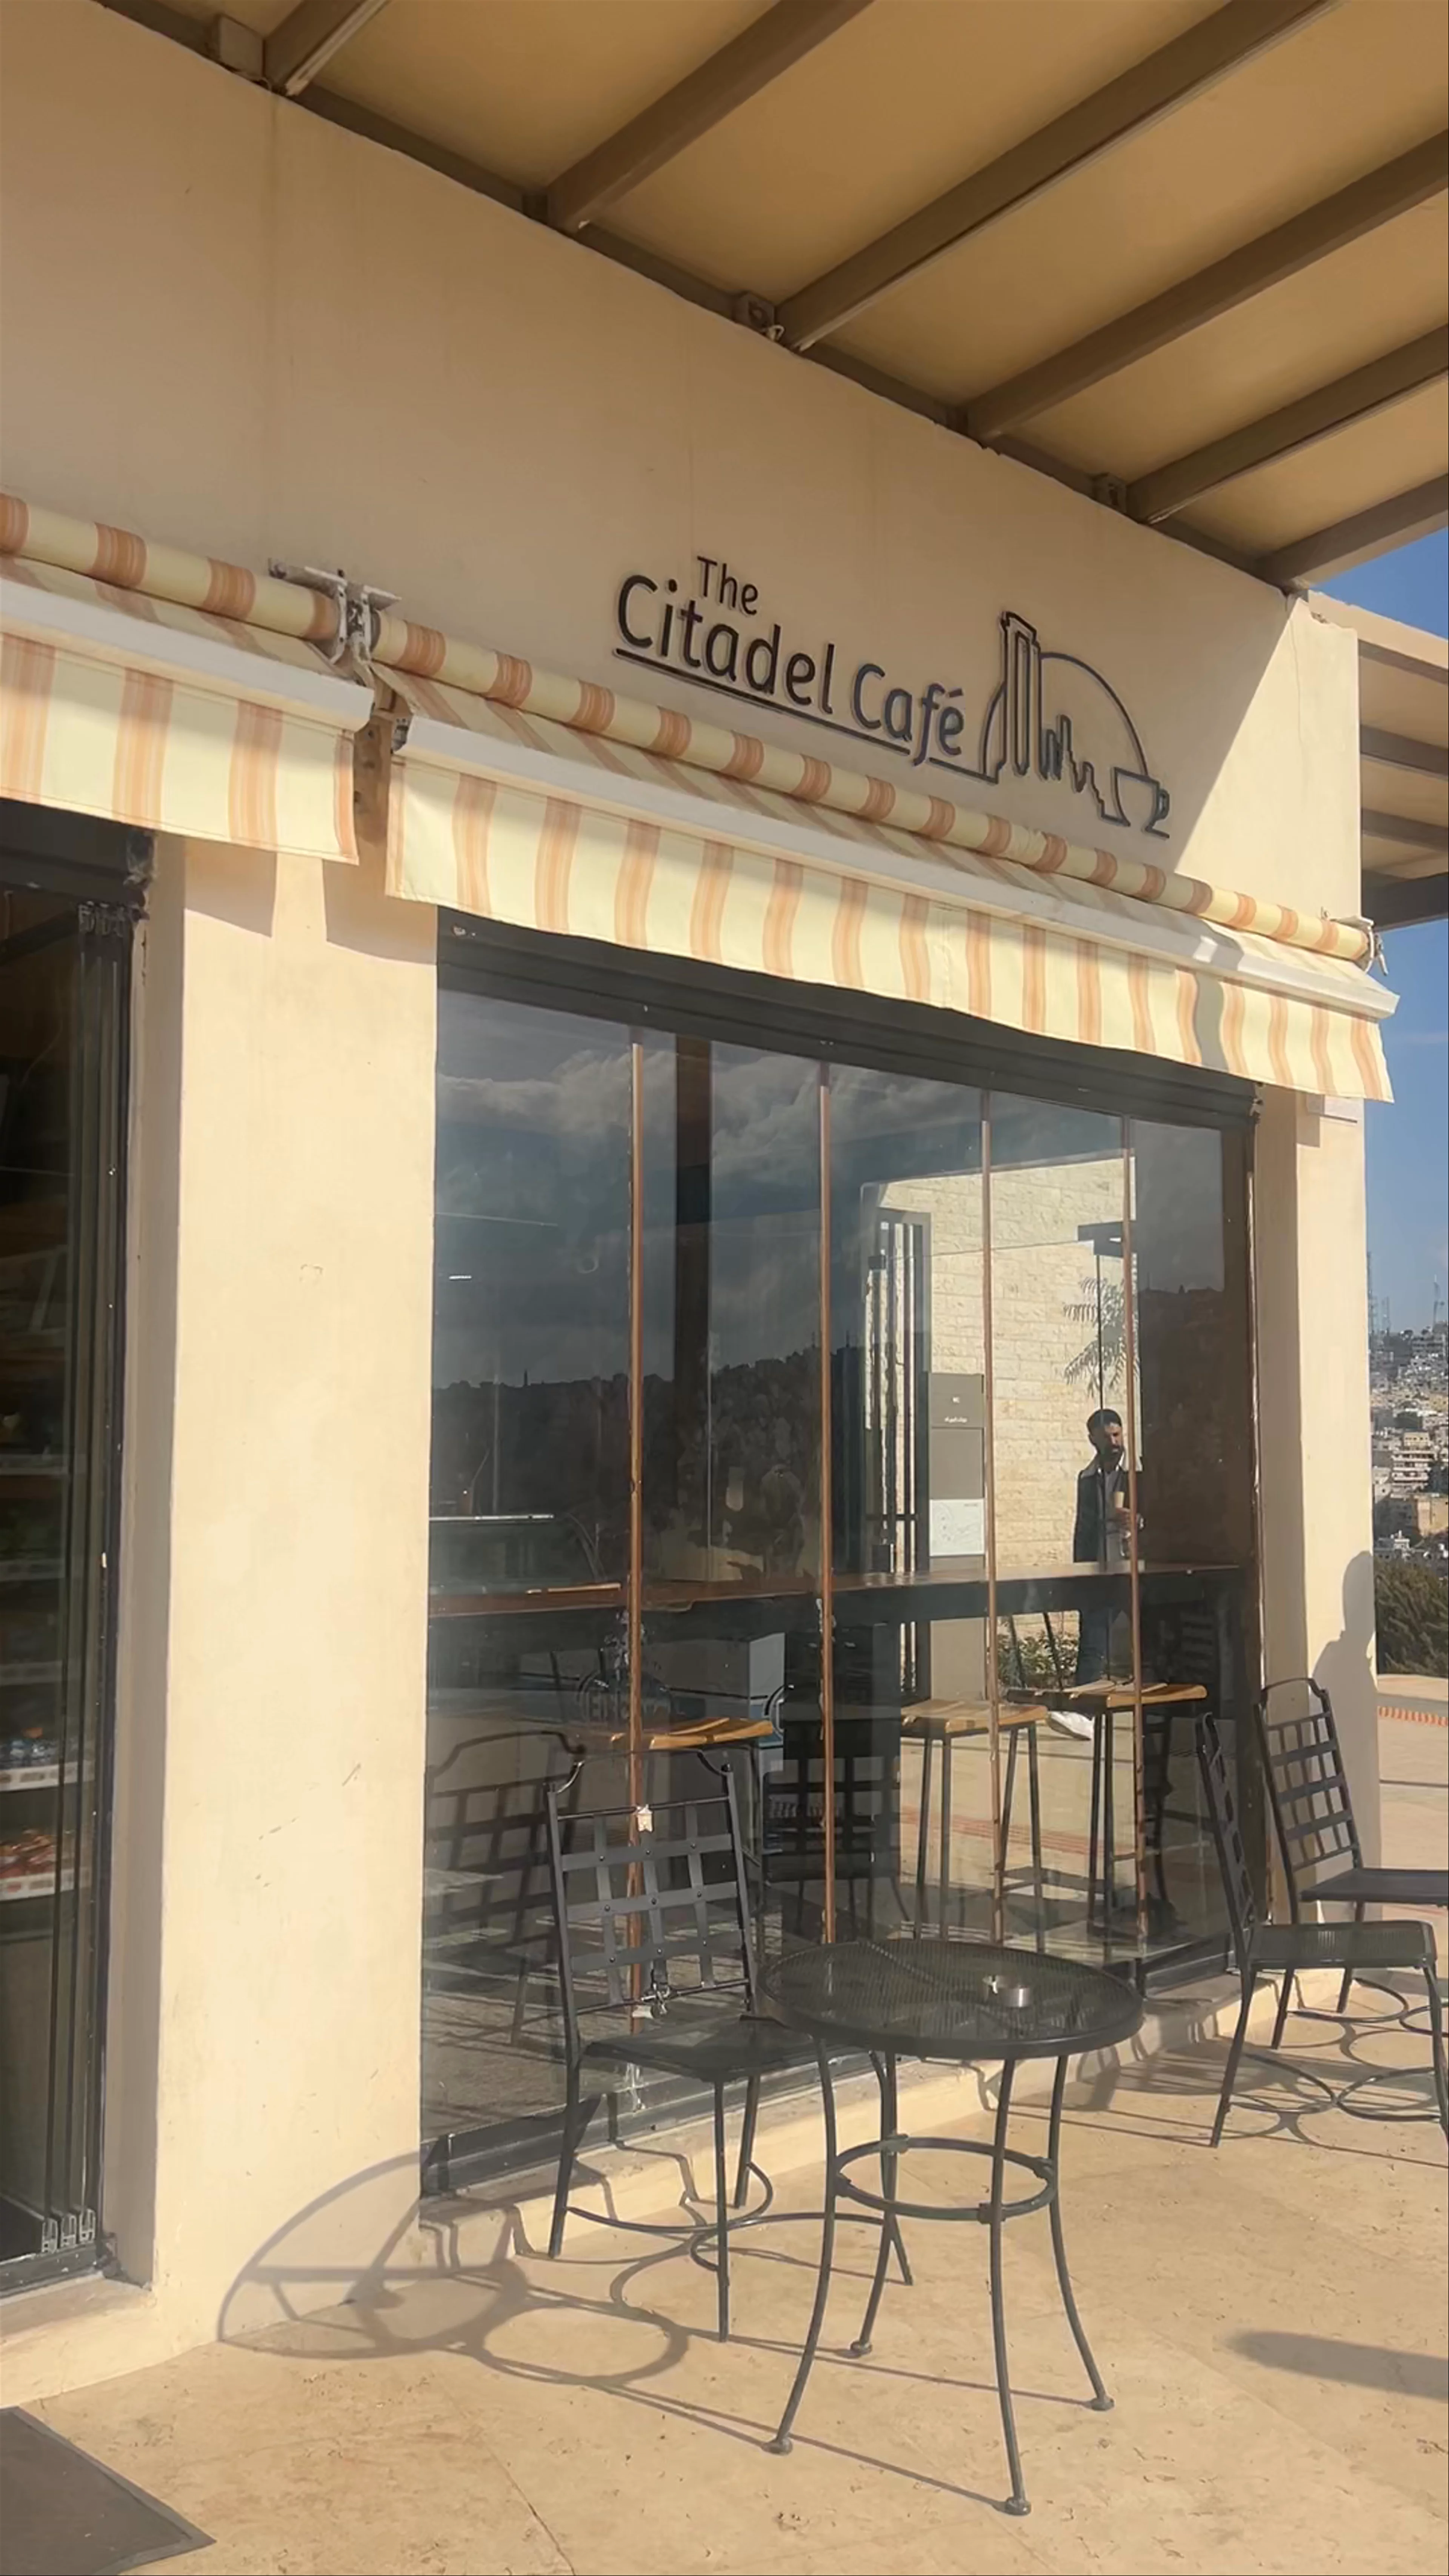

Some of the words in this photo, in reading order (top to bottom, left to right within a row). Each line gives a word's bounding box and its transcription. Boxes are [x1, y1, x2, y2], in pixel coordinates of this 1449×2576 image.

[697, 555, 759, 615] The
[618, 574, 835, 714] Citadel
[854, 663, 964, 766] Café
